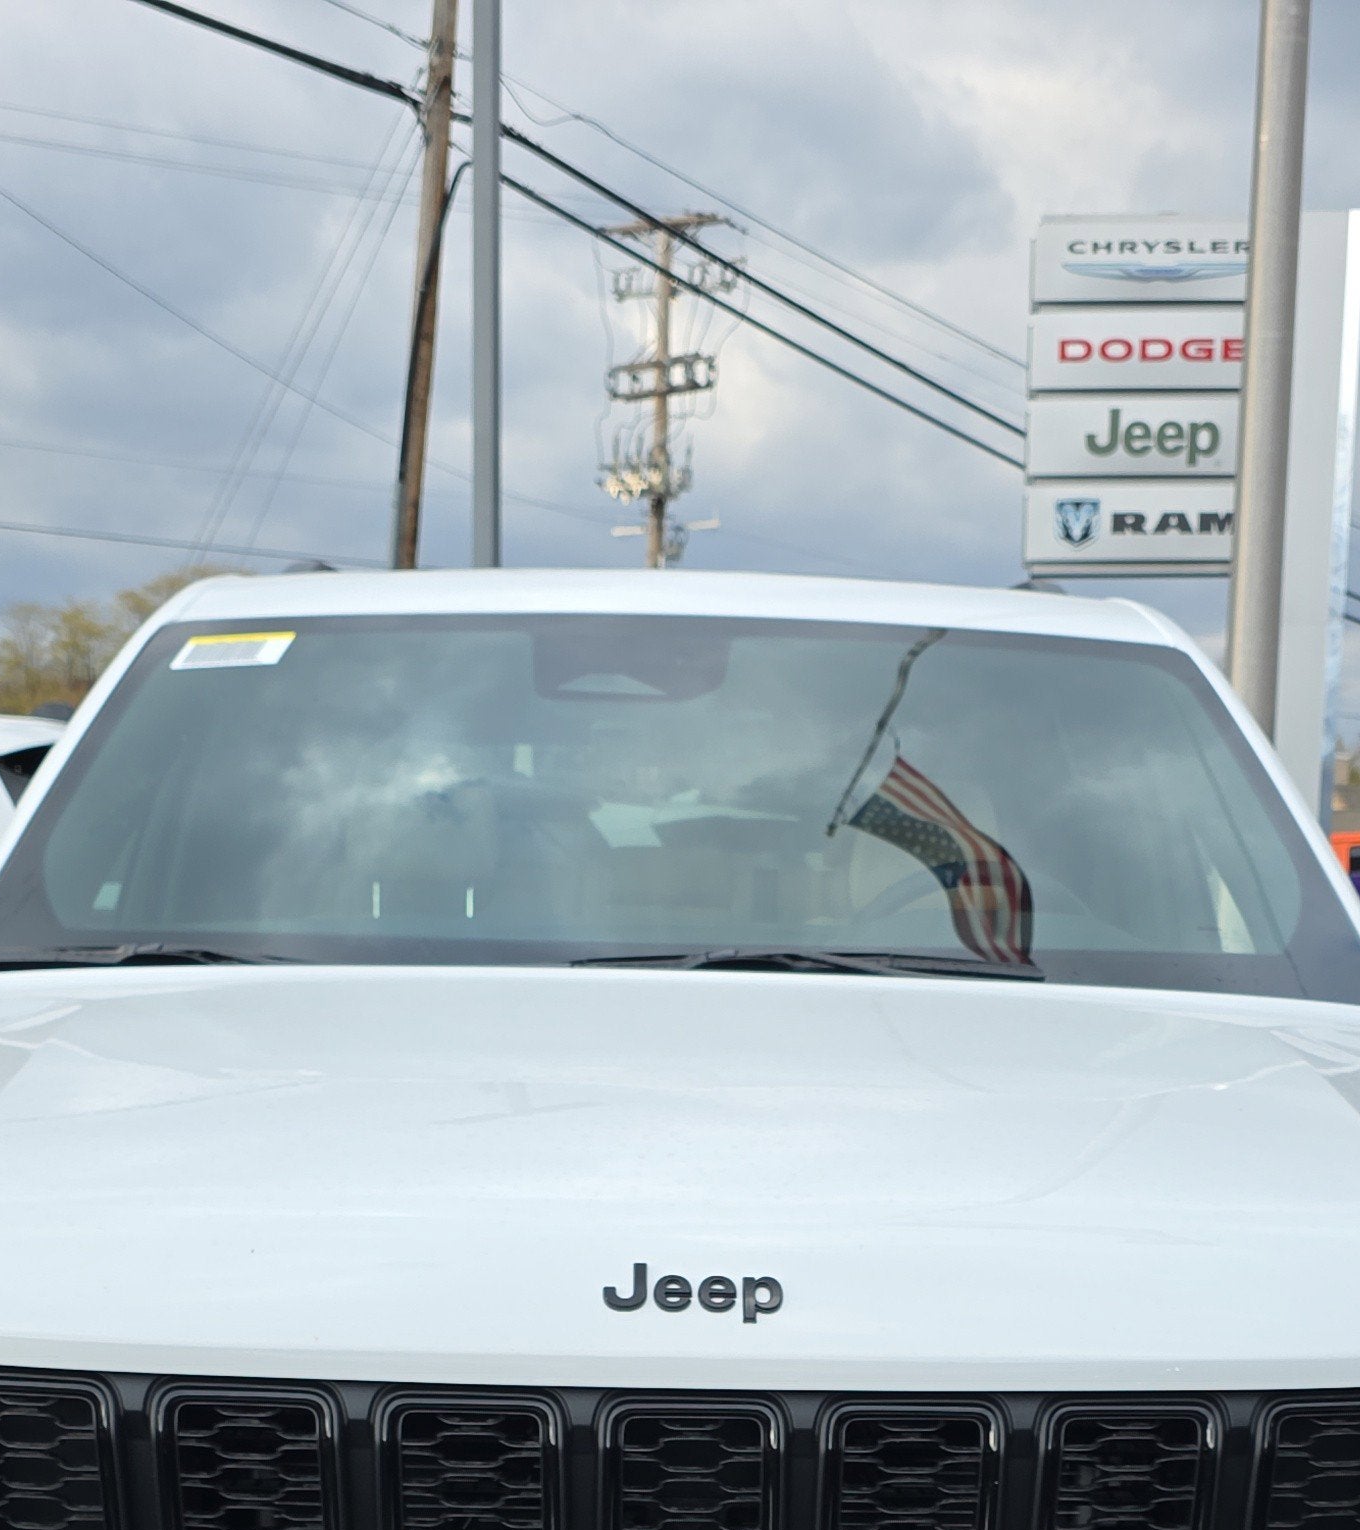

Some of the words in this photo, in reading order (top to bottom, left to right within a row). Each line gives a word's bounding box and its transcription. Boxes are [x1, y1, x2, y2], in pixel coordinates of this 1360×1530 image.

[1067, 239, 1251, 255] CHRYSLER
[1058, 338, 1245, 363] DODGE
[1085, 408, 1220, 465] Jeep
[1111, 511, 1235, 535] RAM
[602, 1262, 784, 1324] Jeep
